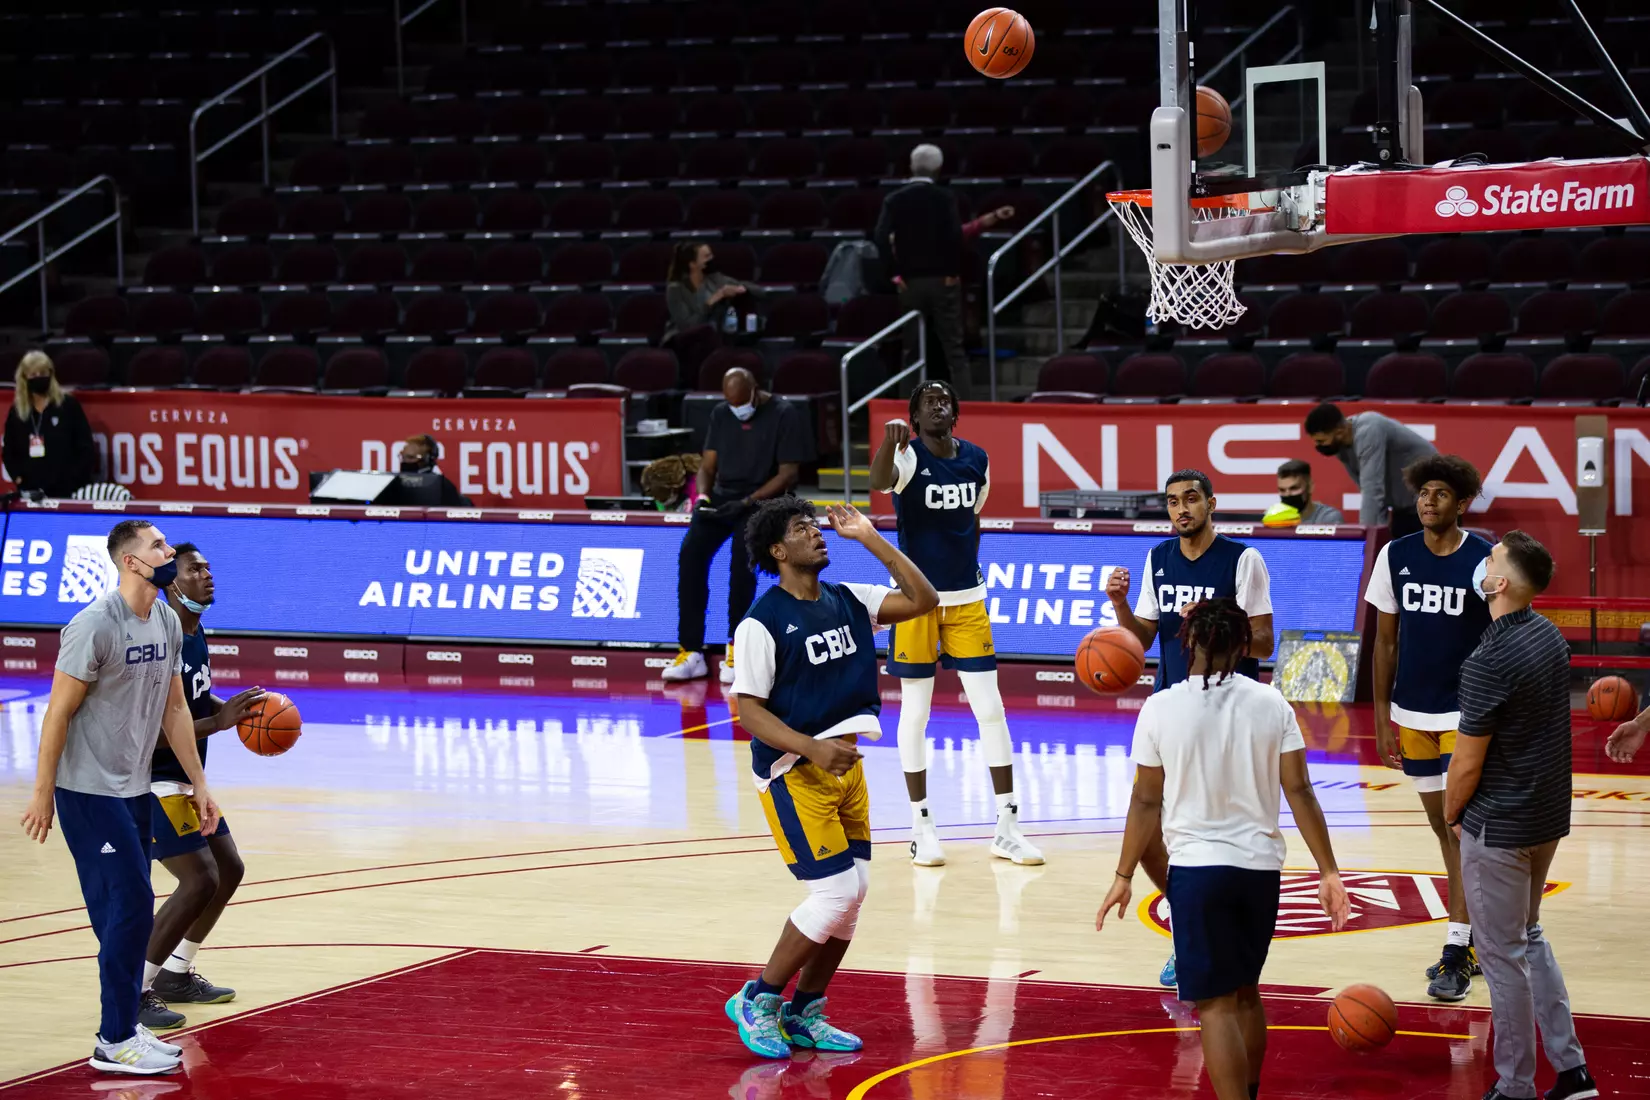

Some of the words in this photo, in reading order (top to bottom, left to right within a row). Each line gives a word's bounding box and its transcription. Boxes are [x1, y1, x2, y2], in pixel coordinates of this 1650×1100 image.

[150, 409, 228, 424] CERVEZA
[432, 418, 516, 431] CERVEZA
[175, 433, 299, 491] EQUIS
[459, 441, 589, 498] EQUIS
[1022, 423, 1650, 515] NISA
[925, 482, 976, 510] CBU
[664, 514, 692, 523] GEIC
[405, 550, 565, 577] UNITED
[979, 562, 1116, 591] NITE
[359, 581, 560, 611] AIRLINES
[1402, 582, 1467, 616] CBU
[988, 597, 1118, 627] LINES
[125, 642, 167, 665] CBU
[805, 624, 858, 666] CBU
